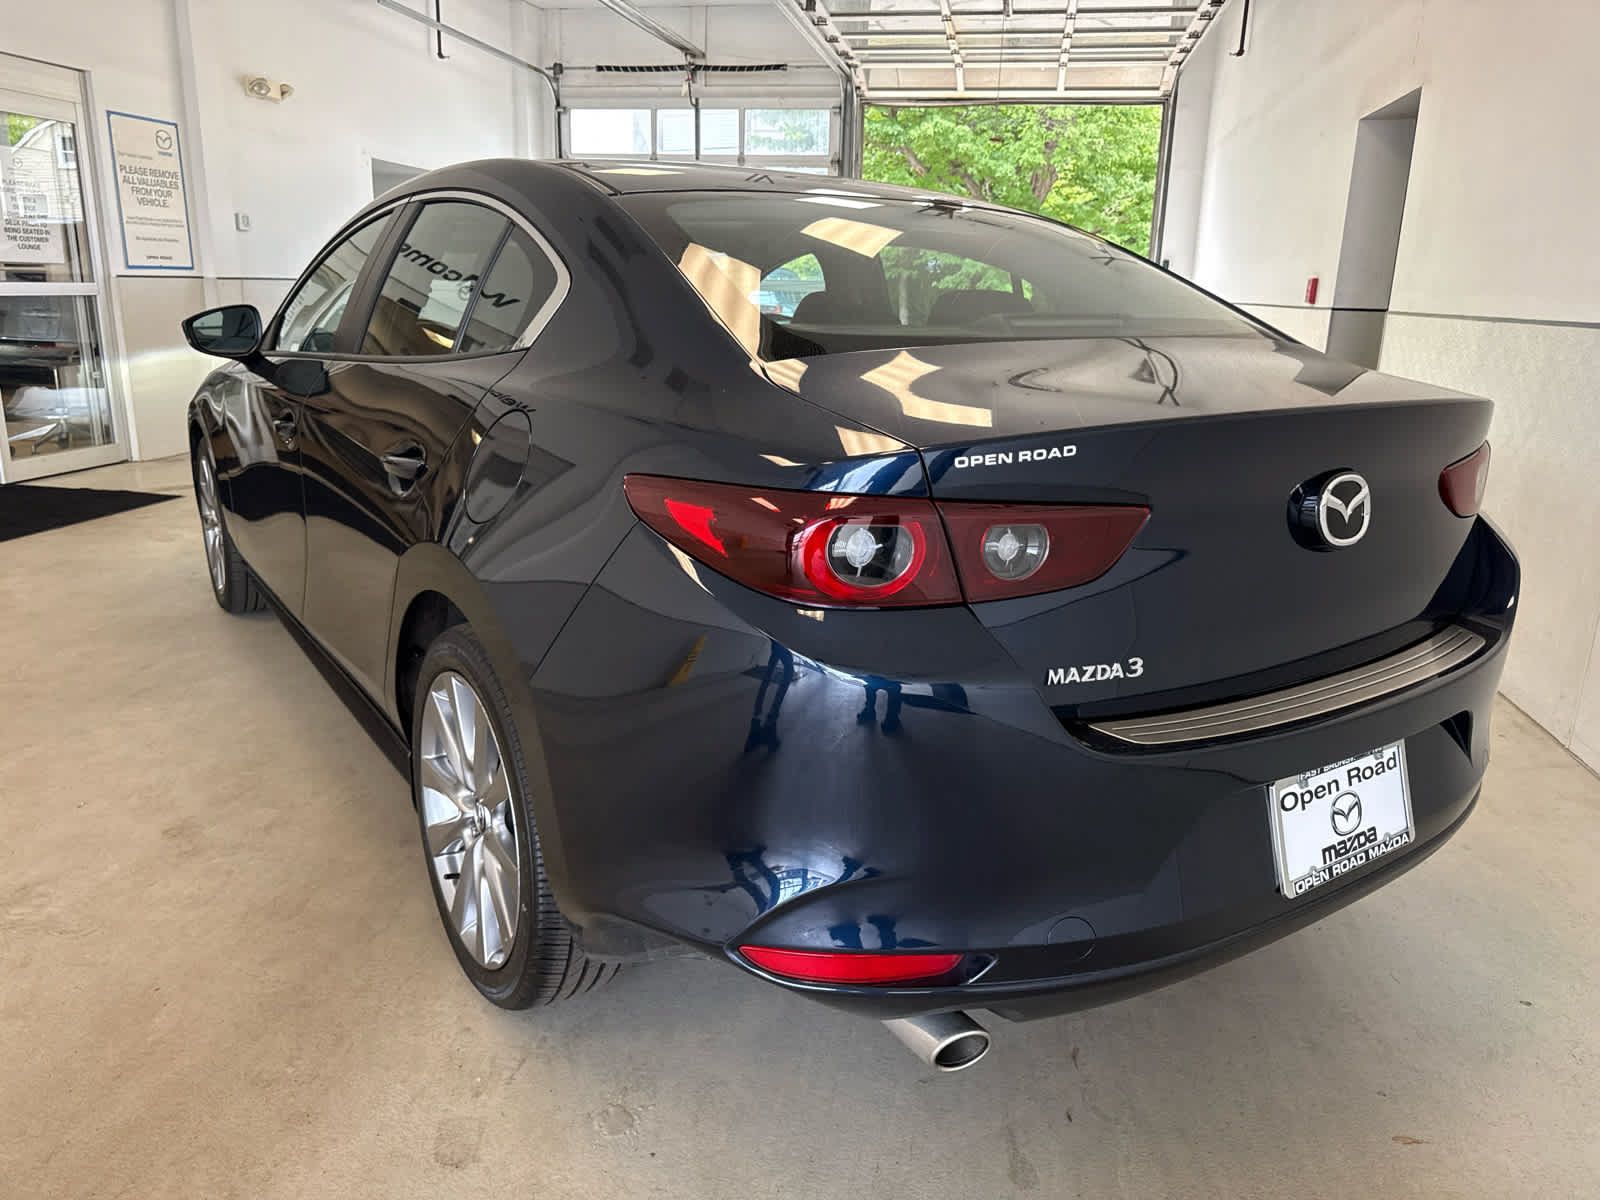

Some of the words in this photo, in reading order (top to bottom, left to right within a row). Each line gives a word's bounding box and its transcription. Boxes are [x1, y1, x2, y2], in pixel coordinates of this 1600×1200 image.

[119, 164, 149, 178] PLEASE
[149, 167, 180, 180] REMOVE
[122, 175, 136, 185] ALL
[136, 177, 179, 190] VALUABLES
[131, 186, 153, 197] FROM
[153, 188, 173, 199] YOUR
[17, 242, 41, 250] LOUNGE
[954, 452, 1013, 468] OPEN
[1018, 445, 1078, 462] ROAD
[1280, 779, 1340, 812] Open
[1346, 751, 1398, 787] Road
[1321, 825, 1378, 865] mazda
[1295, 868, 1330, 894] OPEN
[1332, 852, 1366, 877] ROAD
[1368, 832, 1410, 860] MAZDA
